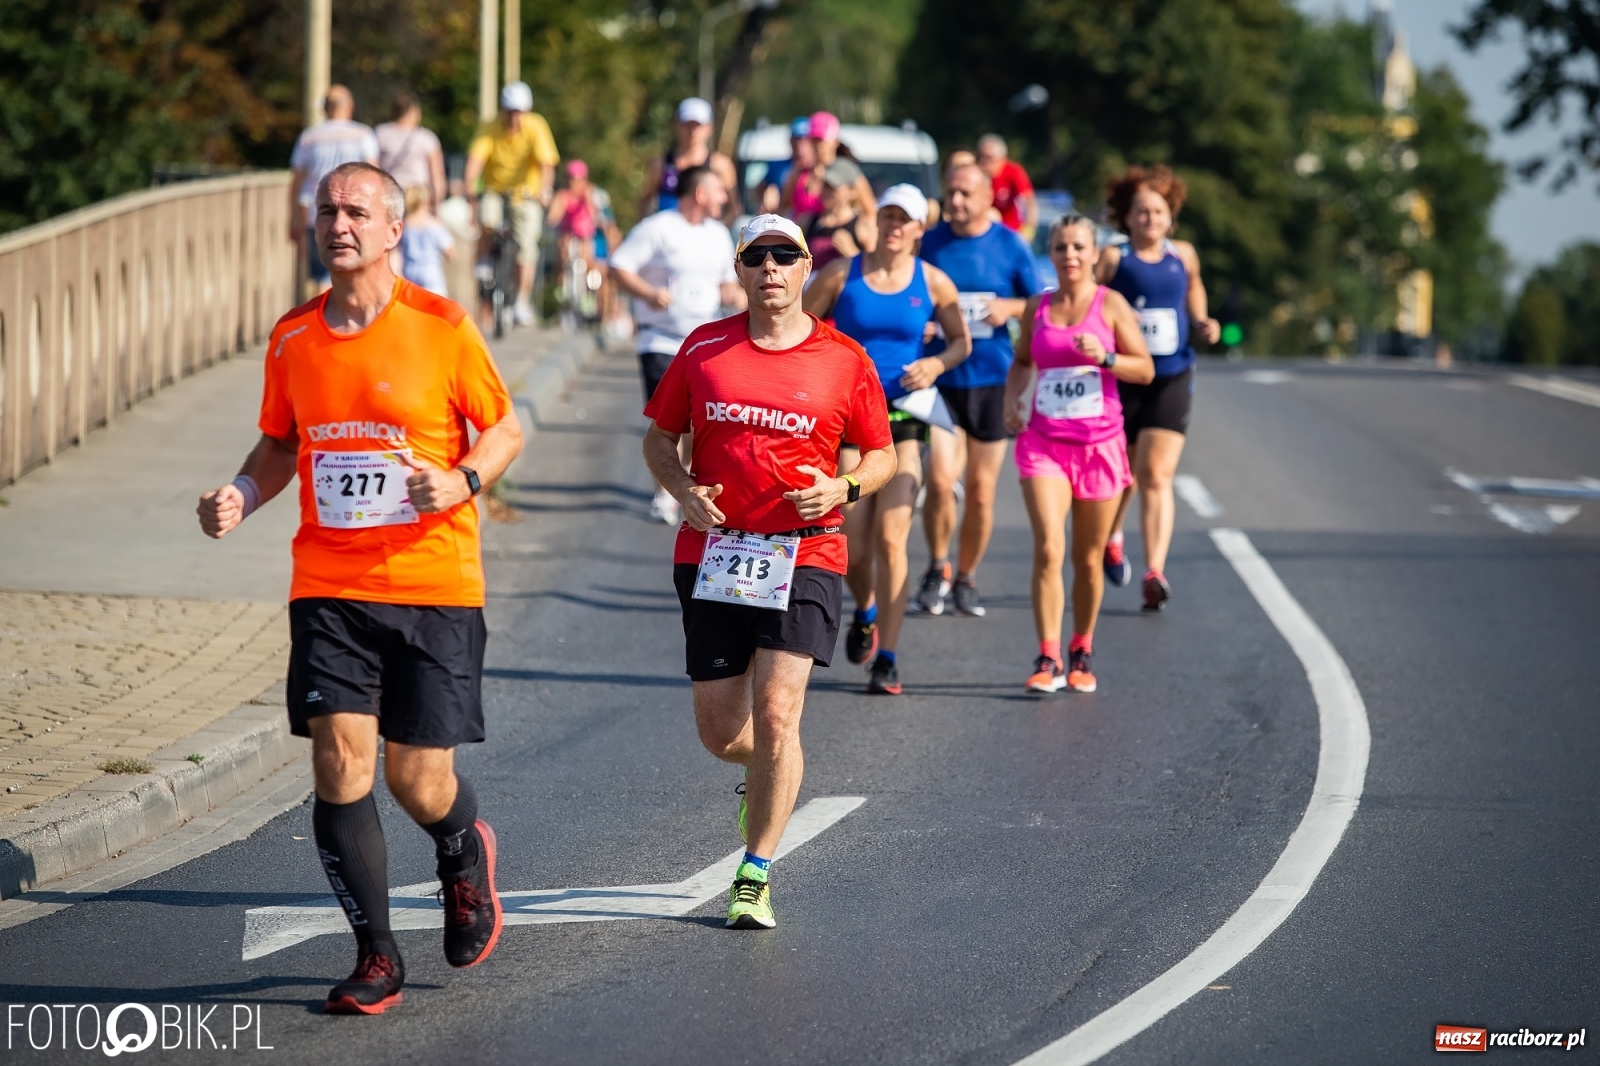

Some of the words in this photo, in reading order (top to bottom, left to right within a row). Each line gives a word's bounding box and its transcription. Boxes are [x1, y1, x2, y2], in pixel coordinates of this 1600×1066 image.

[1054, 382, 1085, 398] 460
[706, 402, 817, 434] DECATHLON
[306, 421, 407, 442] DECATHLON
[339, 473, 386, 497] 277
[726, 554, 771, 580] 213
[736, 579, 754, 587] MAREK
